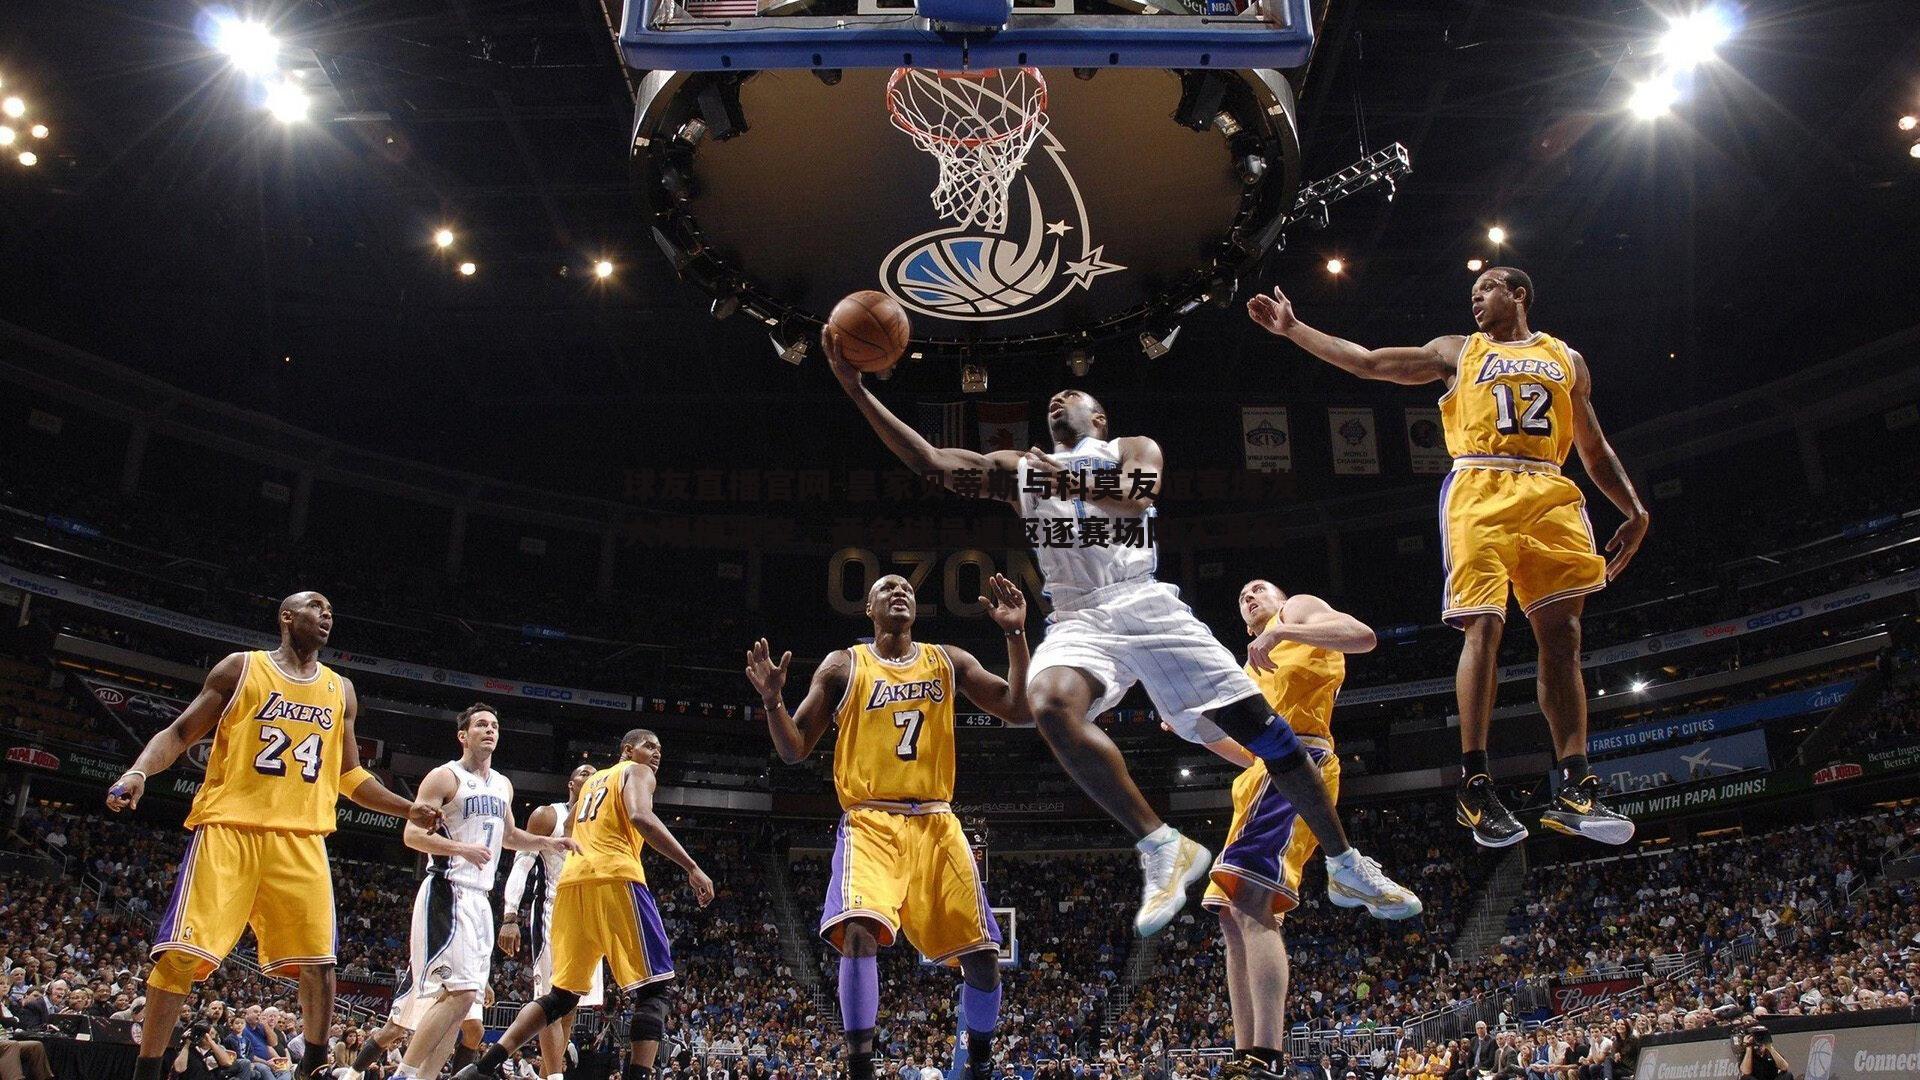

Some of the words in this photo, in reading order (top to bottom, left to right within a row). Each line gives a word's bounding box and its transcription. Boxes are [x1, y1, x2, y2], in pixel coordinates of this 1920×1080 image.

[1211, 2, 1233, 13] NBA
[1475, 352, 1567, 385] LAKERS
[1492, 383, 1553, 436] 12
[9, 575, 58, 597] PEPSICO
[1746, 607, 1804, 629] GEICO
[98, 690, 120, 702] KIA
[522, 685, 573, 700] GEICO
[589, 698, 627, 709] PEPSICO
[865, 679, 945, 711] LAKERS
[254, 692, 333, 730] LAKERS
[966, 715, 992, 726] 4:52
[893, 709, 924, 761] 7
[1593, 735, 1622, 751] FARES
[1625, 733, 1636, 746] TO
[1640, 728, 1664, 743] OVER
[1682, 719, 1715, 735] CITIES
[69, 752, 96, 767] Better
[254, 725, 323, 783] 24
[1868, 749, 1895, 761] Better
[81, 766, 107, 780] Better
[577, 787, 609, 823] 17
[1619, 801, 1645, 816] WIN
[1650, 795, 1681, 812] WITH
[1685, 788, 1716, 806] PAPA
[1720, 778, 1767, 799] JOHNS!
[355, 810, 401, 829] JOHNS!
[483, 822, 494, 848] 7
[1657, 1060, 1700, 1079] Connect
[1702, 1062, 1713, 1077] at
